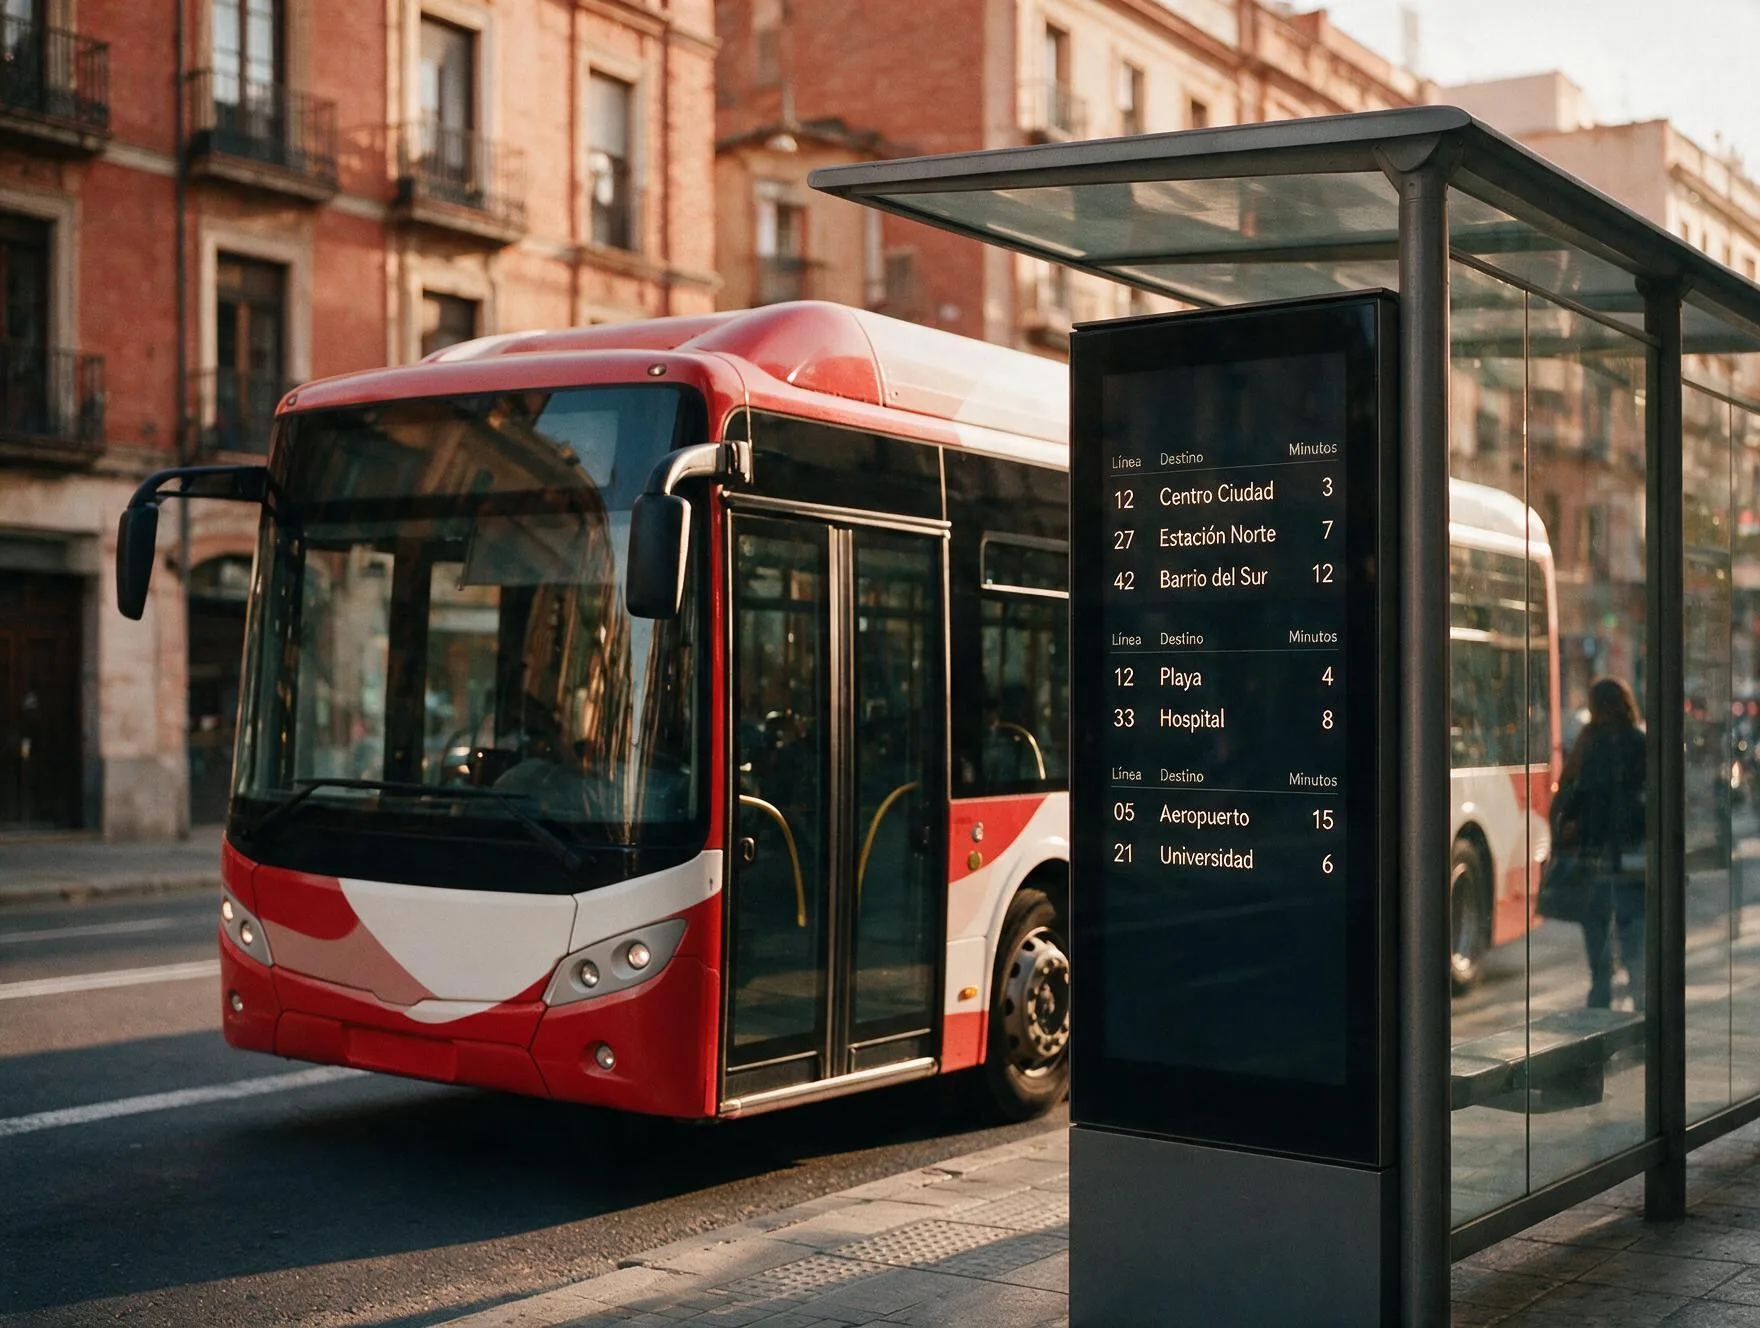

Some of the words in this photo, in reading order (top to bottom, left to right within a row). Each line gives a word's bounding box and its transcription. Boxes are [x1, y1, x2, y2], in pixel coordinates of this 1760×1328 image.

[1112, 454, 1142, 469] Línea
[1160, 450, 1204, 466] Destino
[1289, 441, 1338, 456] Minutos
[1114, 489, 1134, 509] 12
[1159, 486, 1213, 506] Centro
[1217, 479, 1274, 503] Ciudad
[1322, 476, 1333, 497] 3
[1113, 529, 1135, 550] 27
[1159, 524, 1226, 547] Estación
[1230, 524, 1277, 544] Norte
[1322, 520, 1334, 540] 7
[1113, 570, 1135, 591] 42
[1160, 568, 1207, 589] Barrio
[1211, 566, 1236, 587] del
[1240, 566, 1269, 586] Sur
[1312, 563, 1334, 584] 12
[1112, 631, 1142, 646] Línea
[1160, 631, 1204, 646] Destino
[1289, 629, 1338, 643] Minutos
[1114, 667, 1134, 687] 12
[1160, 666, 1202, 692] Playa
[1321, 666, 1334, 686] 4
[1113, 708, 1135, 728] 33
[1160, 707, 1225, 734] Hospital
[1322, 709, 1334, 730] 8
[1112, 766, 1142, 781] Línea
[1160, 768, 1204, 783] Destino
[1289, 772, 1338, 787] Minutos
[1113, 802, 1135, 822] 05
[1159, 803, 1250, 830] Aeropuerto
[1312, 809, 1334, 830] 15
[1113, 842, 1132, 863] 21
[1160, 845, 1254, 870] Universidad
[1322, 853, 1334, 874] 6
